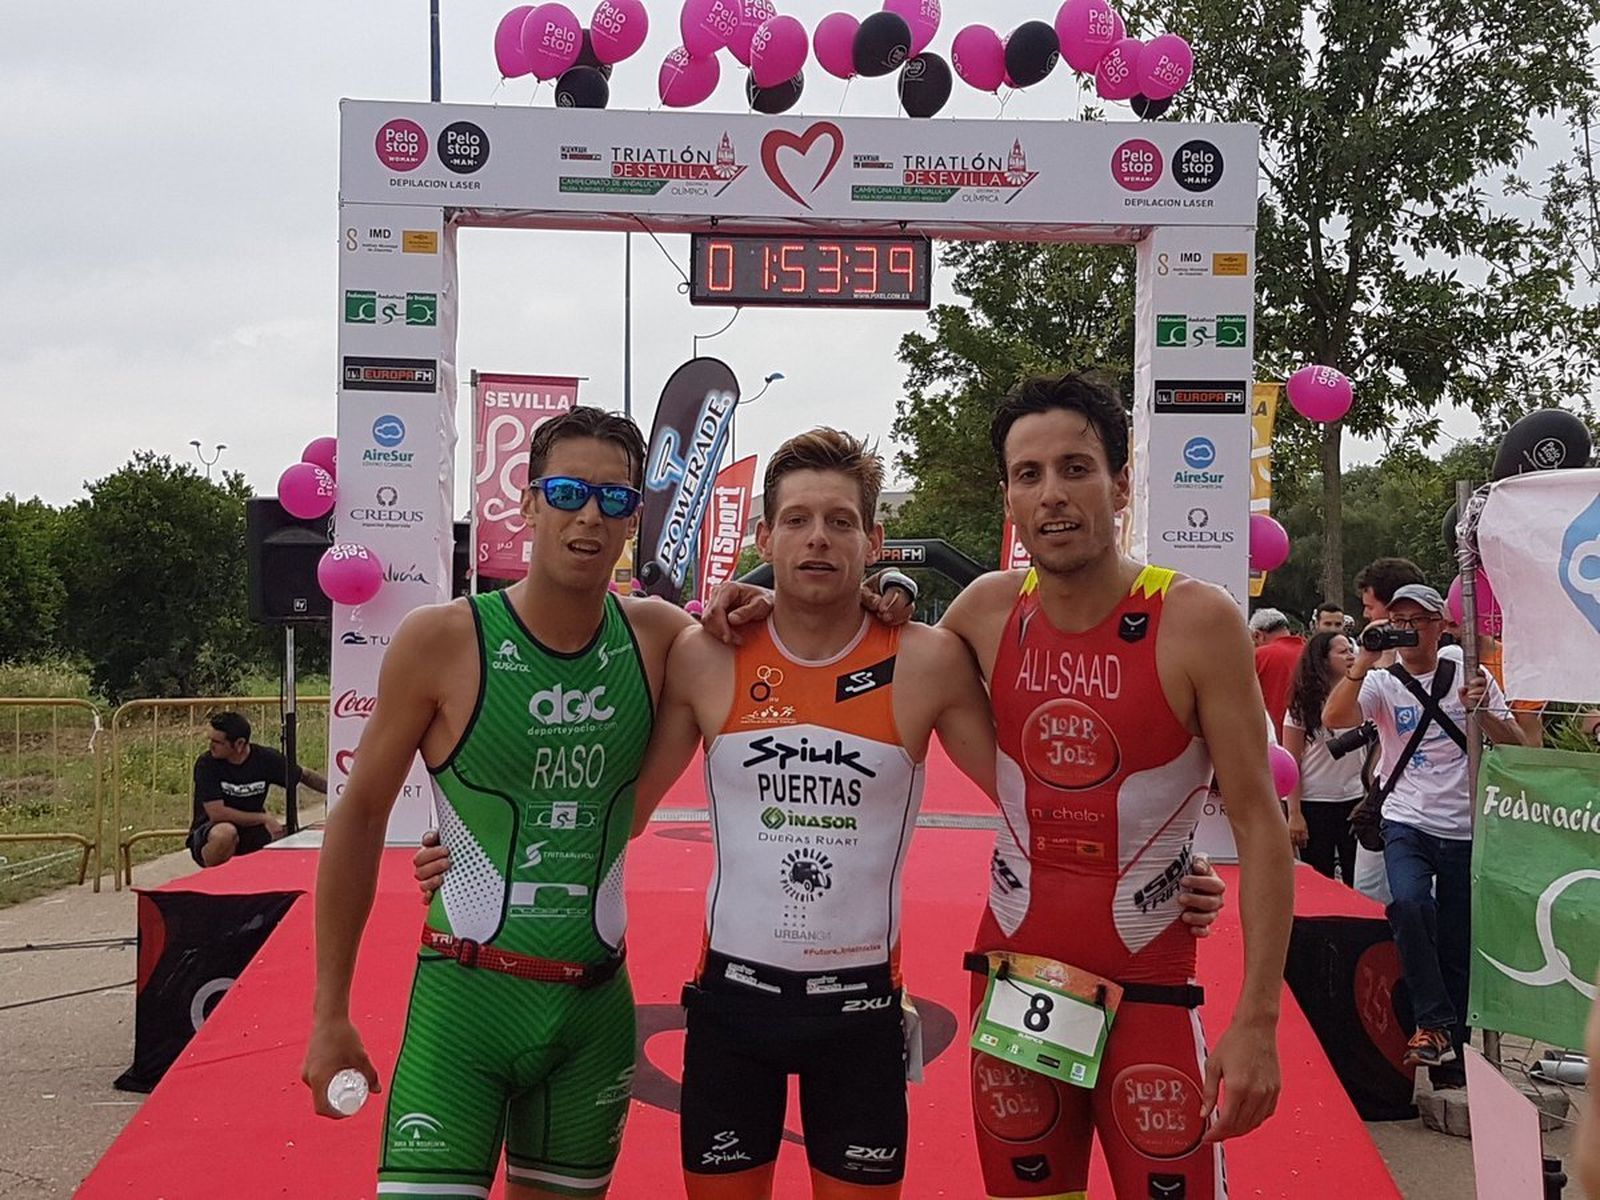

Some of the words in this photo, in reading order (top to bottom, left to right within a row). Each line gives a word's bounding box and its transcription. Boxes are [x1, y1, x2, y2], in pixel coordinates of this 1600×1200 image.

[600, 1, 626, 24] Pelo
[712, 1, 738, 27] Pelo
[595, 12, 621, 34] stop
[706, 12, 734, 37] stop
[545, 22, 576, 42] Pelo
[542, 35, 573, 55] stop
[1109, 48, 1129, 77] Pelo
[1159, 55, 1184, 77] Pelo
[1154, 66, 1180, 86] stop
[385, 128, 418, 143] Pelo
[447, 131, 480, 145] Pelo
[385, 141, 418, 156] stop
[447, 143, 480, 158] stop
[611, 145, 711, 164] TRIATLÓN
[1121, 148, 1154, 163] Pelo
[1182, 150, 1214, 163] Pelo
[903, 152, 1002, 170] TRIATLÓN
[1121, 161, 1154, 176] stop
[611, 163, 633, 177] DE
[636, 164, 711, 179] SEVILLA
[1182, 162, 1214, 177] stop
[450, 180, 481, 190] LASER
[903, 171, 925, 184] DE
[928, 172, 1002, 186] SEVILLA
[1183, 199, 1214, 208] LASER
[369, 228, 392, 239] IMD
[1180, 252, 1202, 263] IMD
[485, 390, 570, 410] SEVILLA
[362, 448, 414, 462] AireSur
[660, 397, 728, 565] POWERADE
[1174, 471, 1224, 484] AireSur
[350, 508, 423, 523] CREDUS
[1162, 530, 1234, 543] CREDUS
[1014, 647, 1121, 700] ALI-SAAD
[531, 743, 606, 790] RASO
[757, 773, 862, 807] PUERTAS
[1023, 993, 1054, 1032] 8
